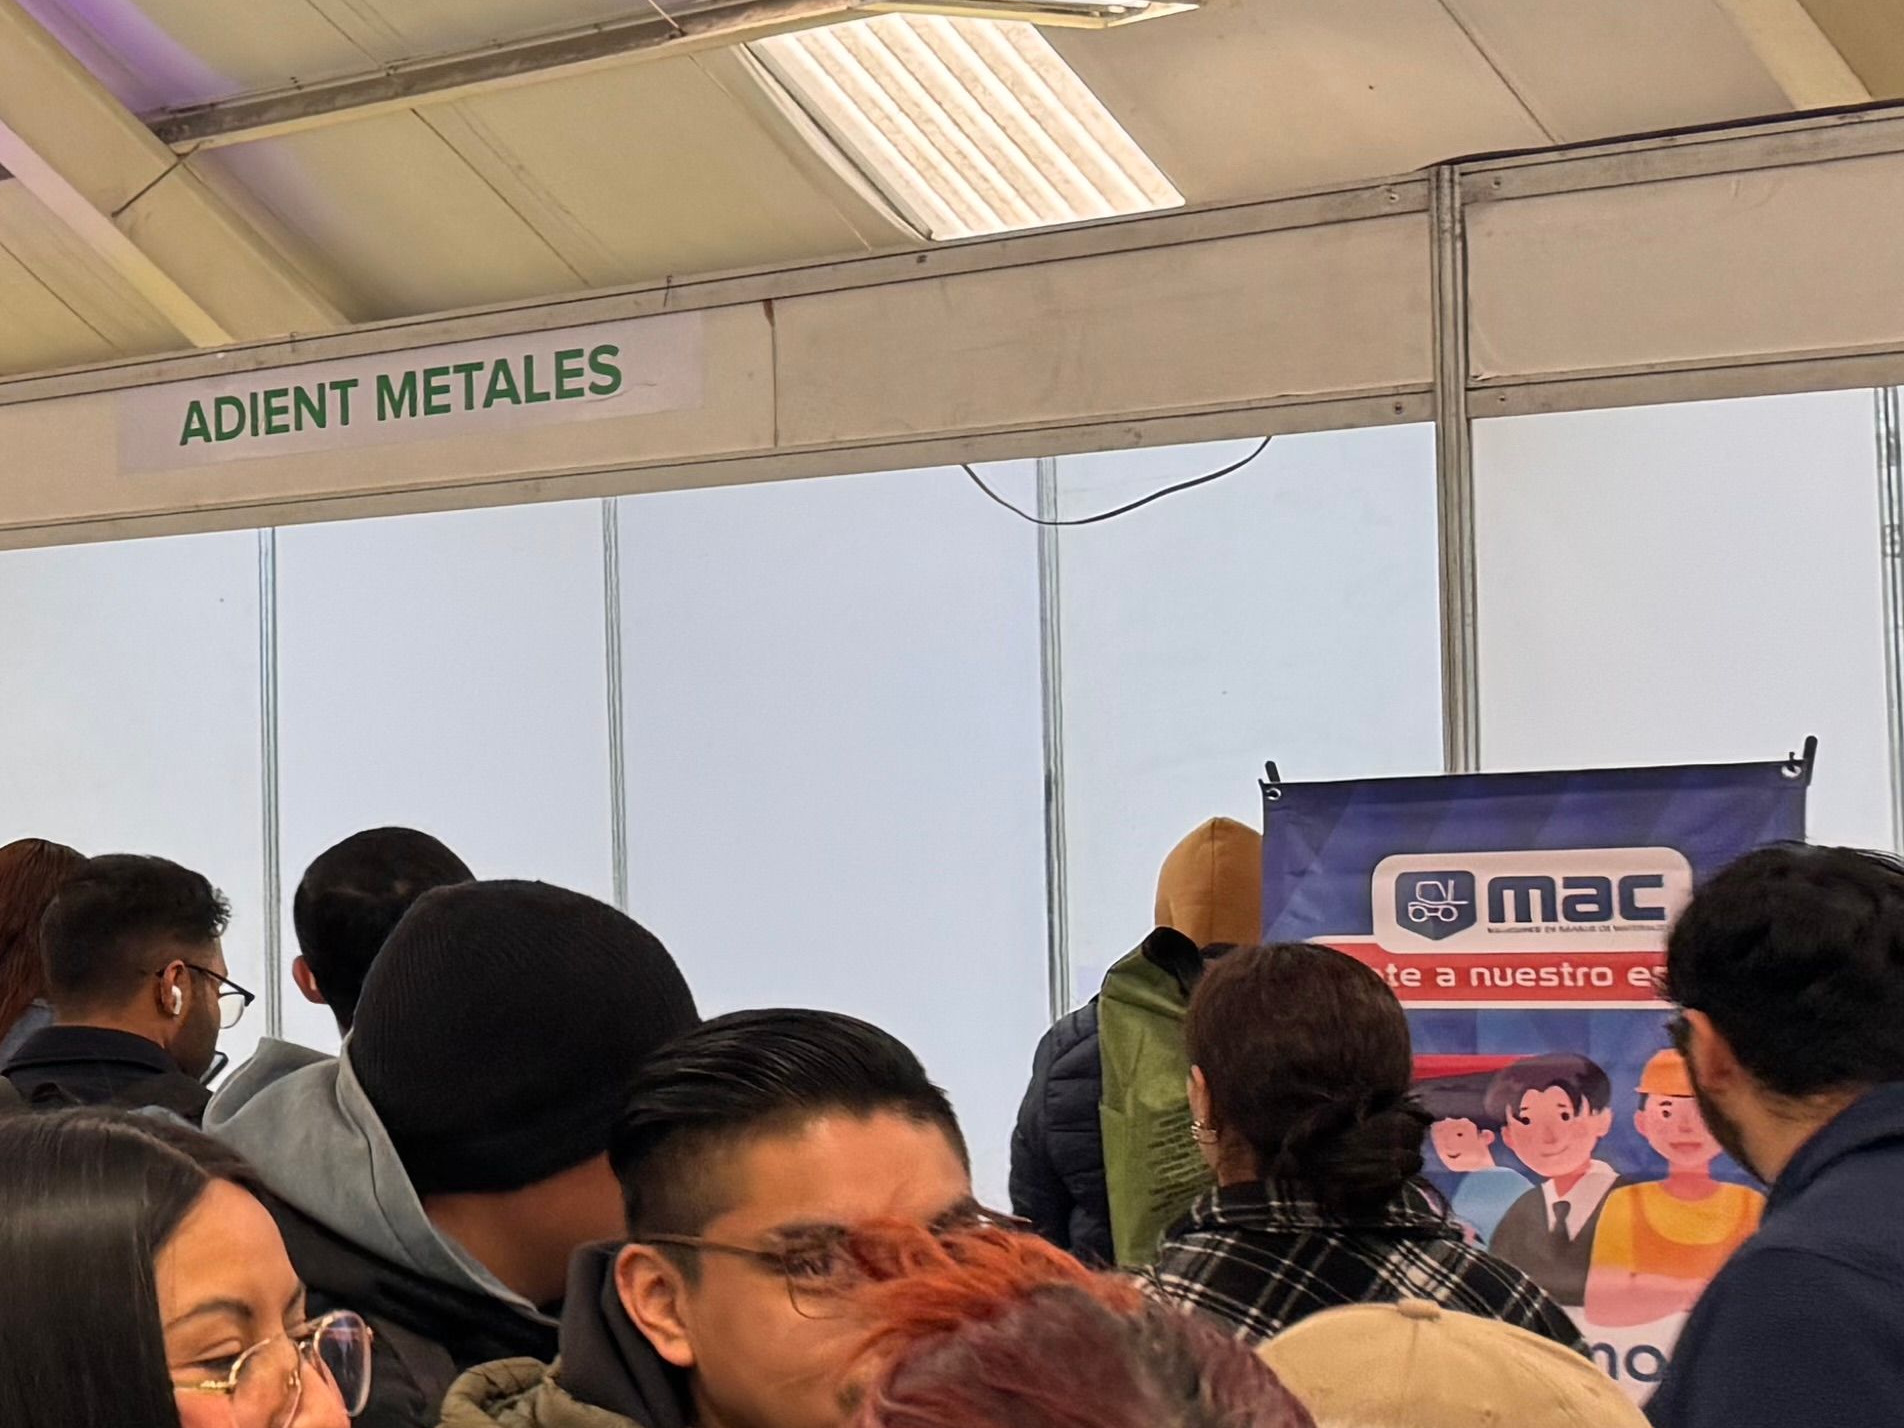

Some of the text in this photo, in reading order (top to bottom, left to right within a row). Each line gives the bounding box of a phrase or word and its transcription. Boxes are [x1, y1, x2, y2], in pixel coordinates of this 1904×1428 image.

[178, 344, 622, 446] ADIENT METALES
[1488, 874, 1665, 922] mac
[1436, 967, 1456, 987] a
[1470, 962, 1613, 988] nuestro
